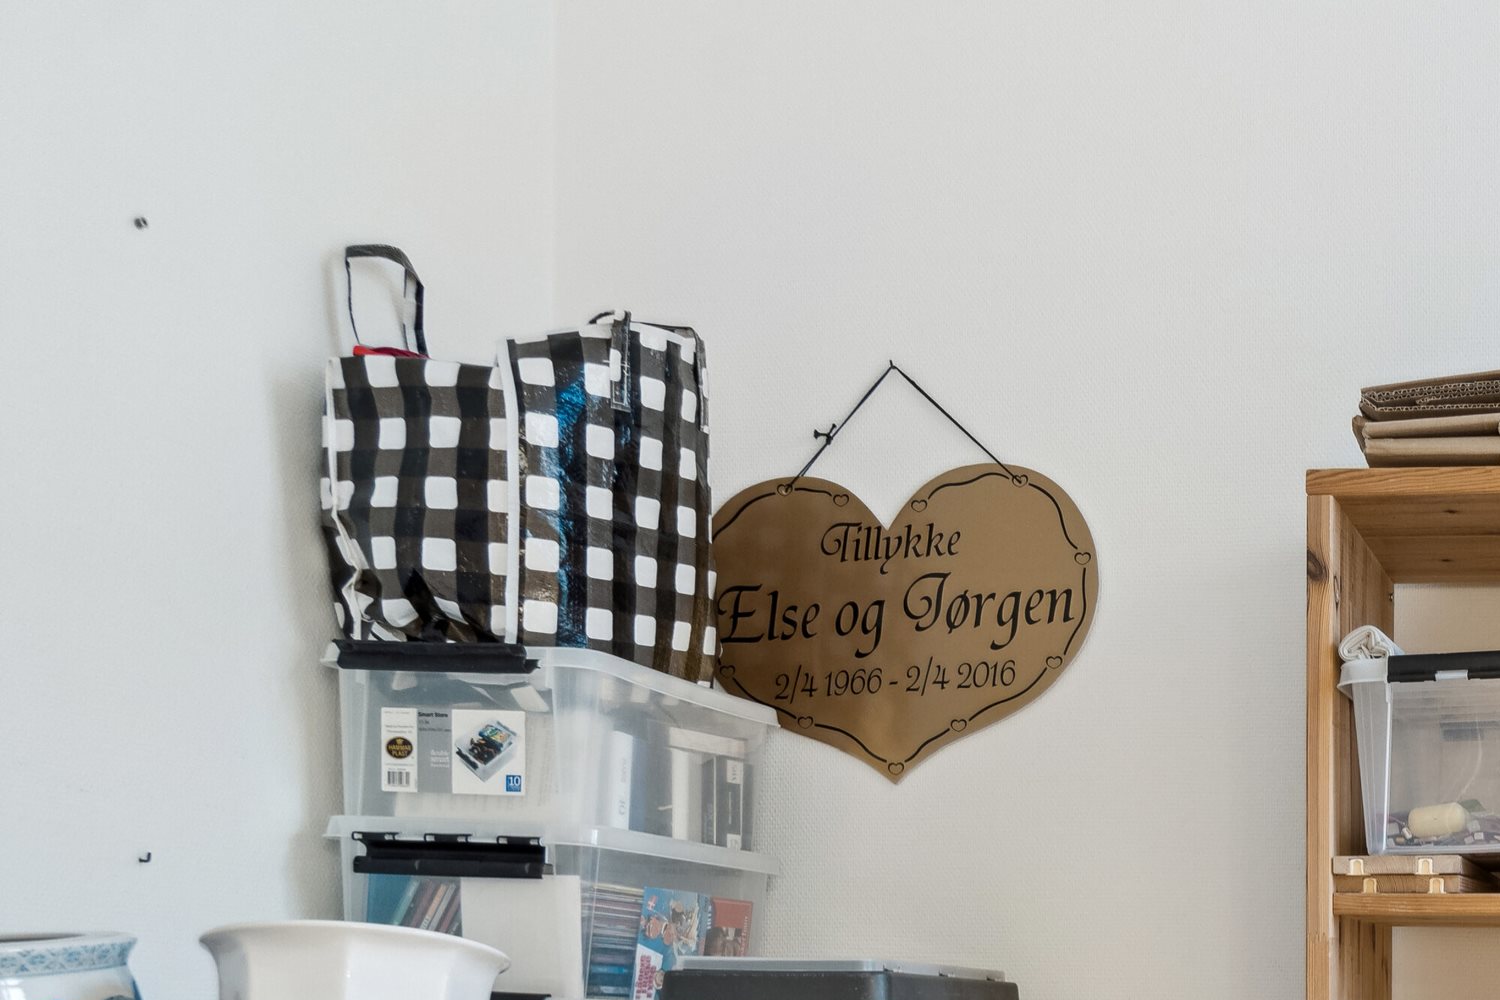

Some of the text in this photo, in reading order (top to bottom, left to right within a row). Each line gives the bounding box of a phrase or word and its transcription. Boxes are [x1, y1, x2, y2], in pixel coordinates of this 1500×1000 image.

[820, 521, 961, 576] Tillykke
[716, 571, 1075, 659] Else og Jørgen
[774, 664, 818, 705] 2/4
[825, 667, 883, 697] 1966
[905, 655, 950, 697] 2/4
[956, 659, 1017, 690] 2016
[508, 776, 521, 787] 10
